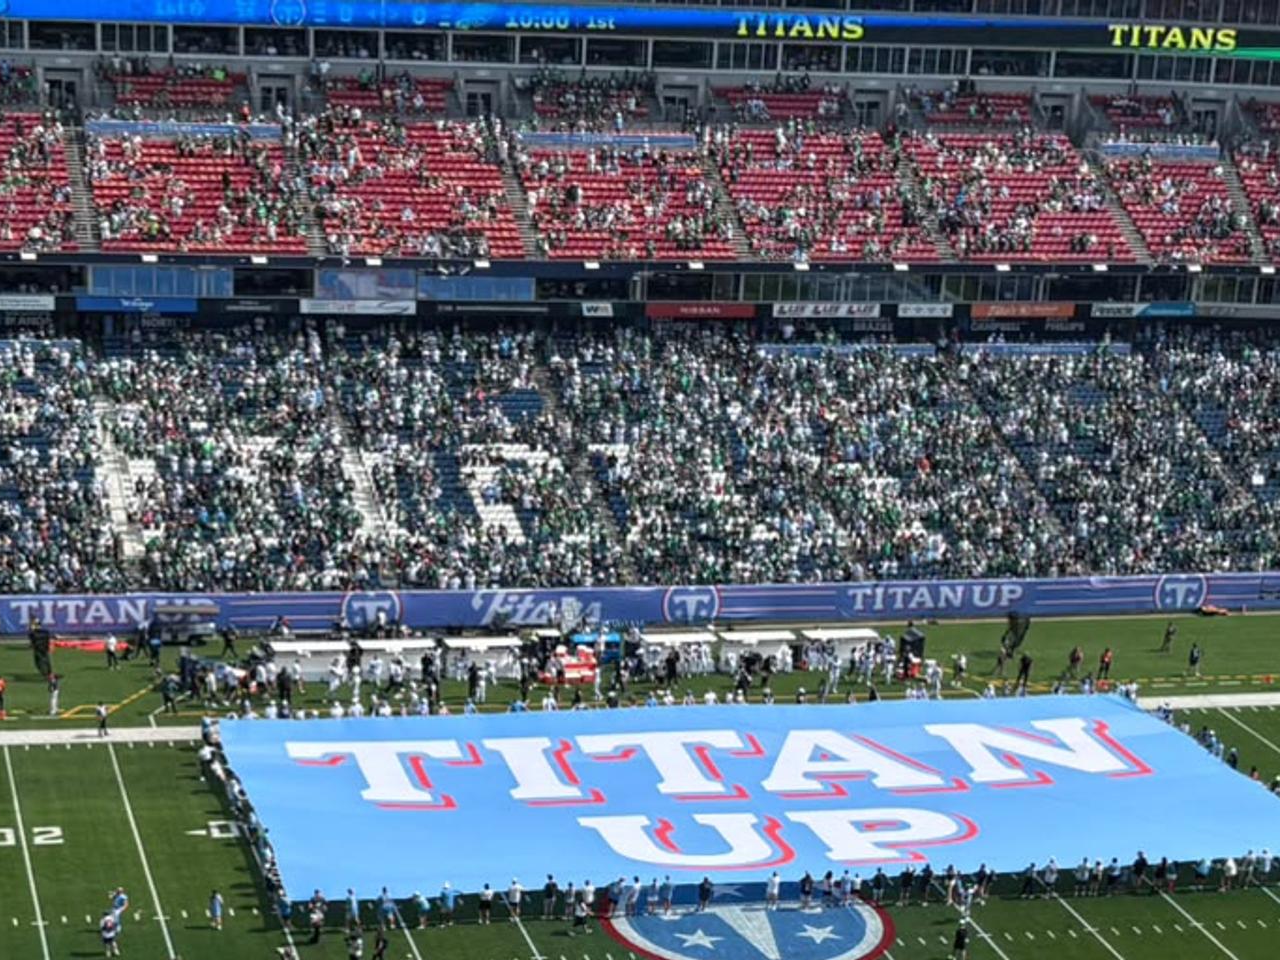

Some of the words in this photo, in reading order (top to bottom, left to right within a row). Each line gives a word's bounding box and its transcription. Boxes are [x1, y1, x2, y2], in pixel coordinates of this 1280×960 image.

[736, 13, 865, 39] TITANS
[1108, 24, 1237, 51] TITANS
[847, 584, 966, 612] TITAN
[971, 584, 1023, 608] UP
[10, 600, 148, 625] TITAN
[284, 716, 1151, 810] TITAN
[578, 806, 982, 871] UP
